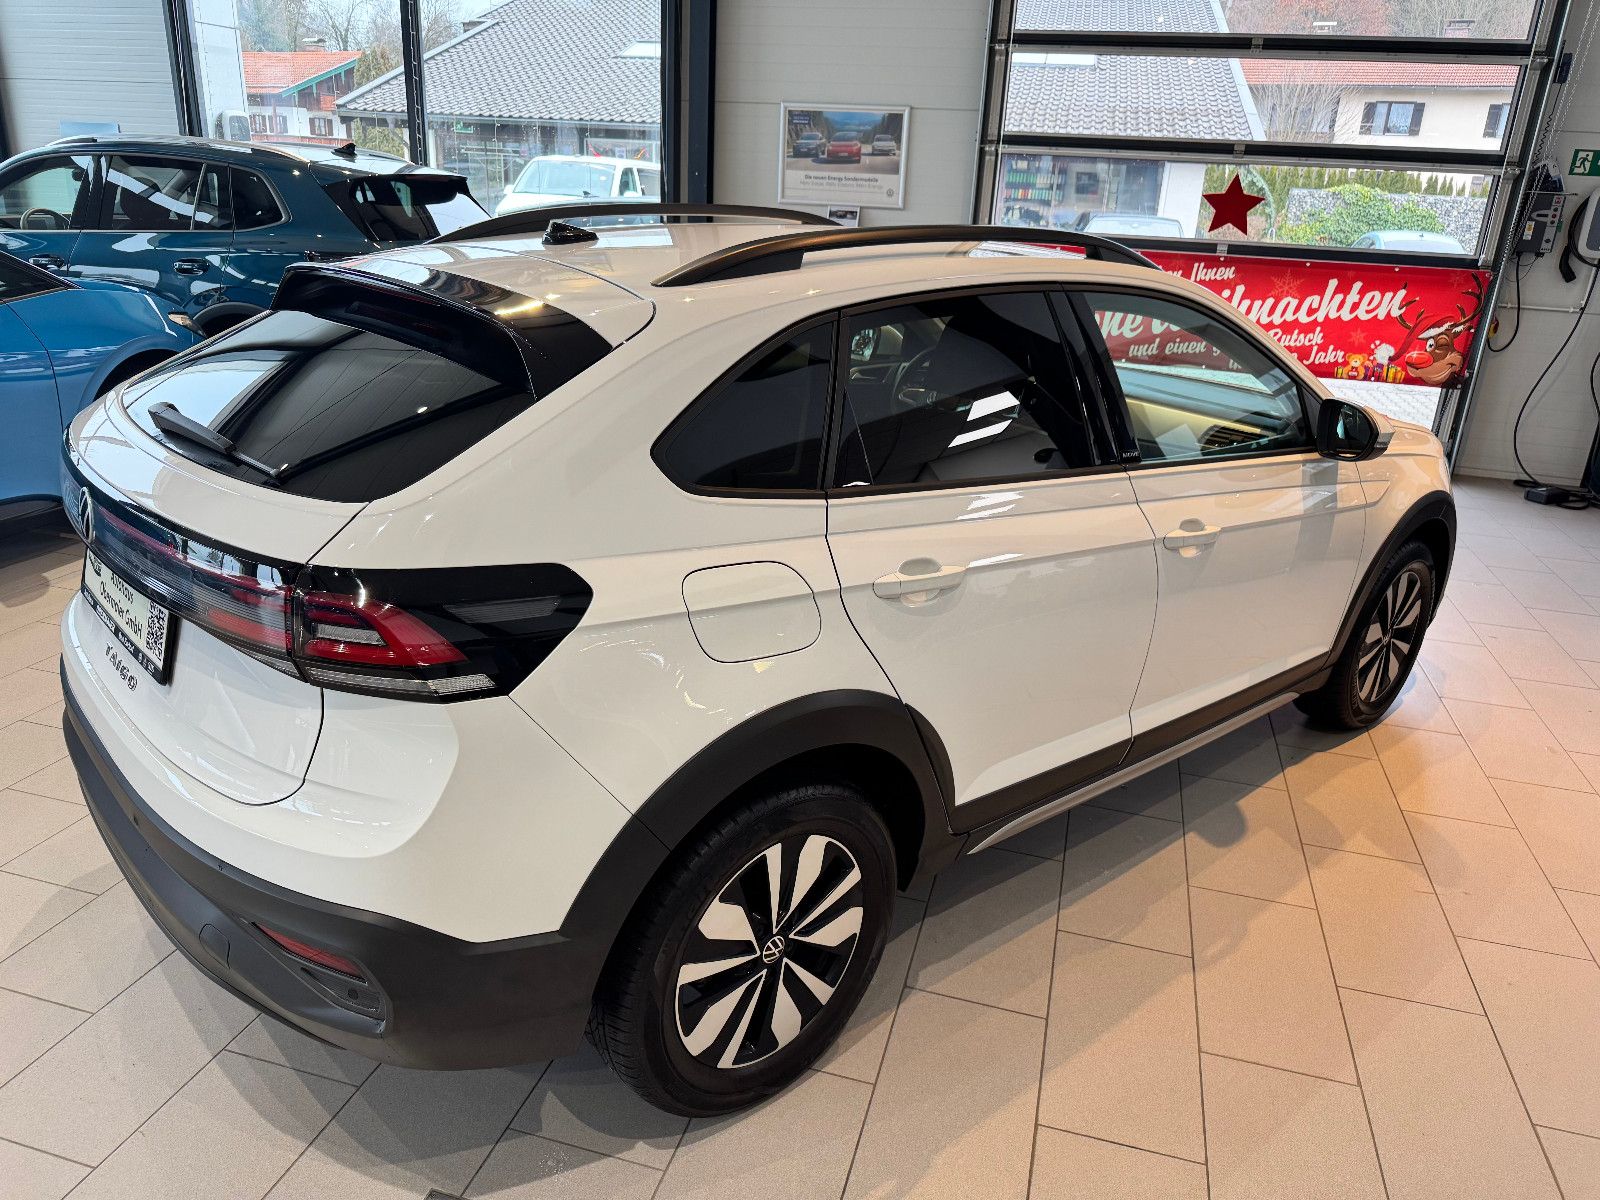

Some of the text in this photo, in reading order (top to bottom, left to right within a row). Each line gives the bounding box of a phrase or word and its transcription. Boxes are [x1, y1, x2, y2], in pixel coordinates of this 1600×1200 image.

[844, 175, 879, 183] Sondermodelle
[1191, 262, 1236, 282] Ihnen
[1129, 338, 1160, 357] und
[1164, 338, 1207, 356] einen
[1303, 345, 1345, 365] Jahr
[125, 609, 143, 640] GmbH
